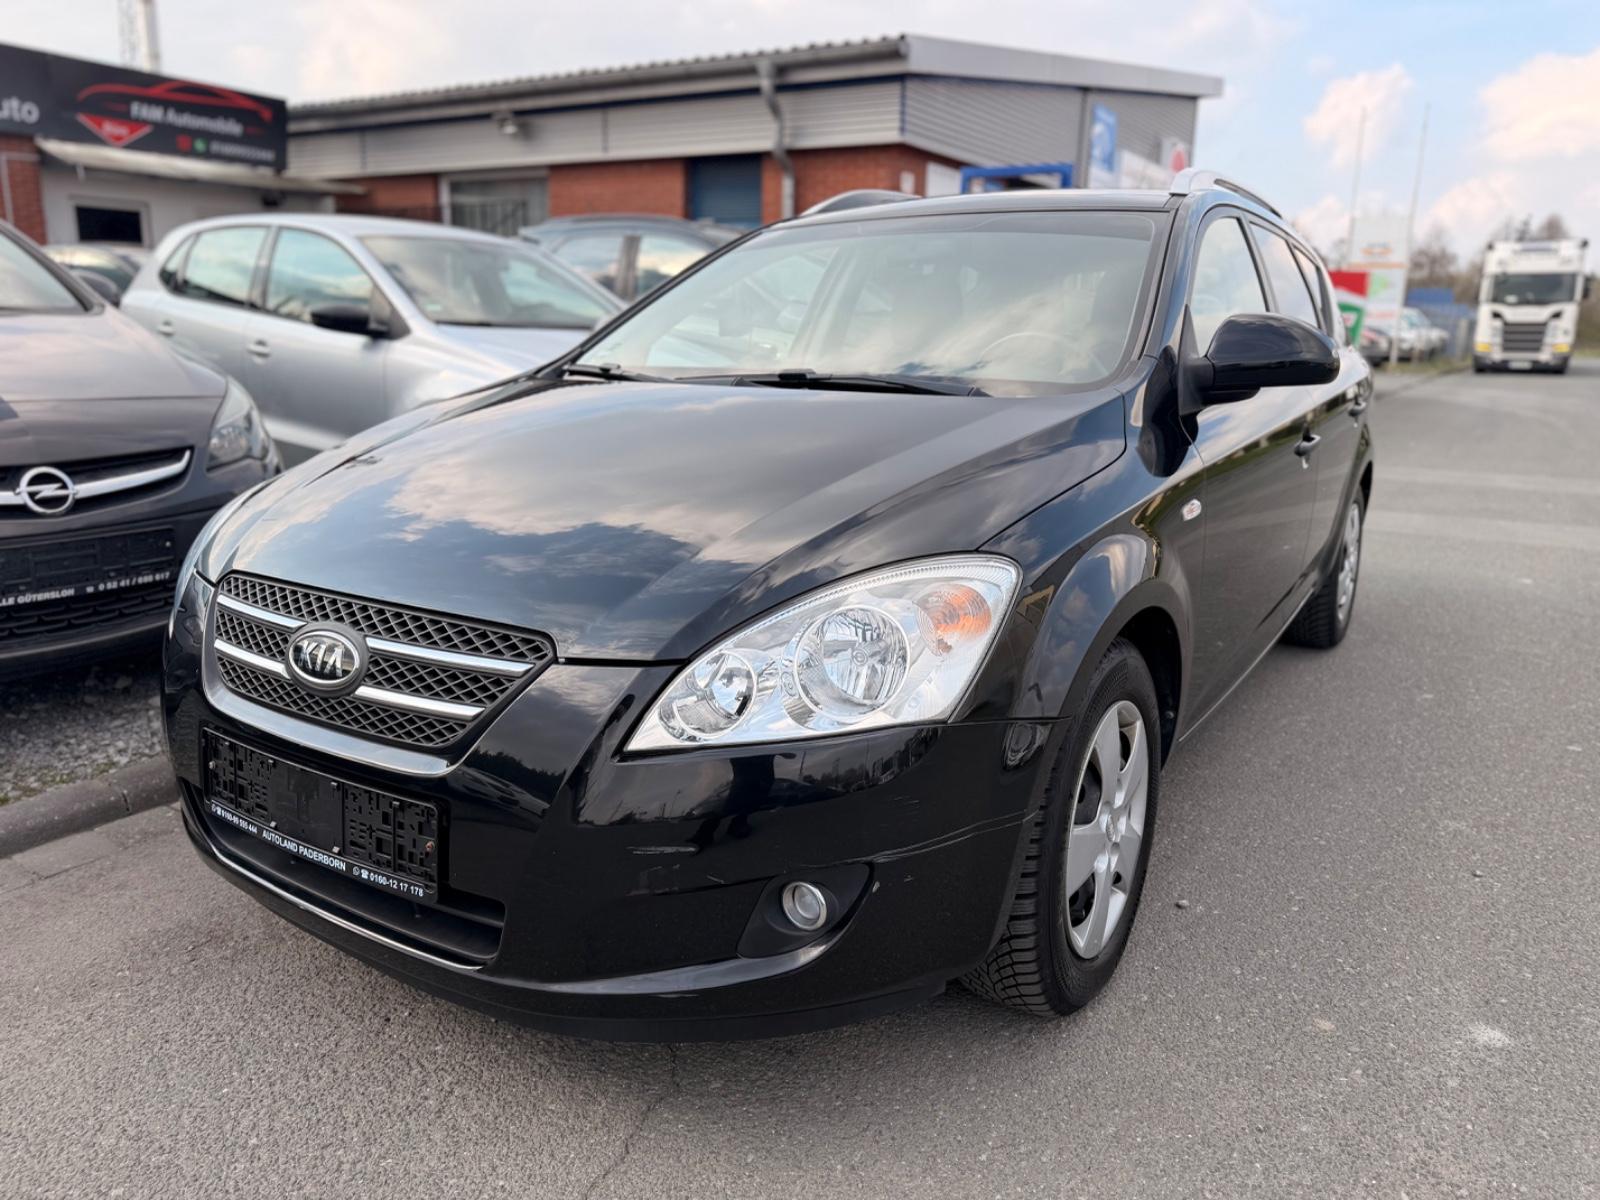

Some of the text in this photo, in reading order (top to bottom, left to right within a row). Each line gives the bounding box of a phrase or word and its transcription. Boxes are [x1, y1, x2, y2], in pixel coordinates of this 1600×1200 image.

[297, 640, 344, 677] KIA
[262, 829, 298, 852] AUTOLAND
[298, 845, 346, 871] PADERBORN
[369, 872, 398, 890] 0160-12
[400, 882, 409, 893] 17
[410, 885, 424, 897] 178
